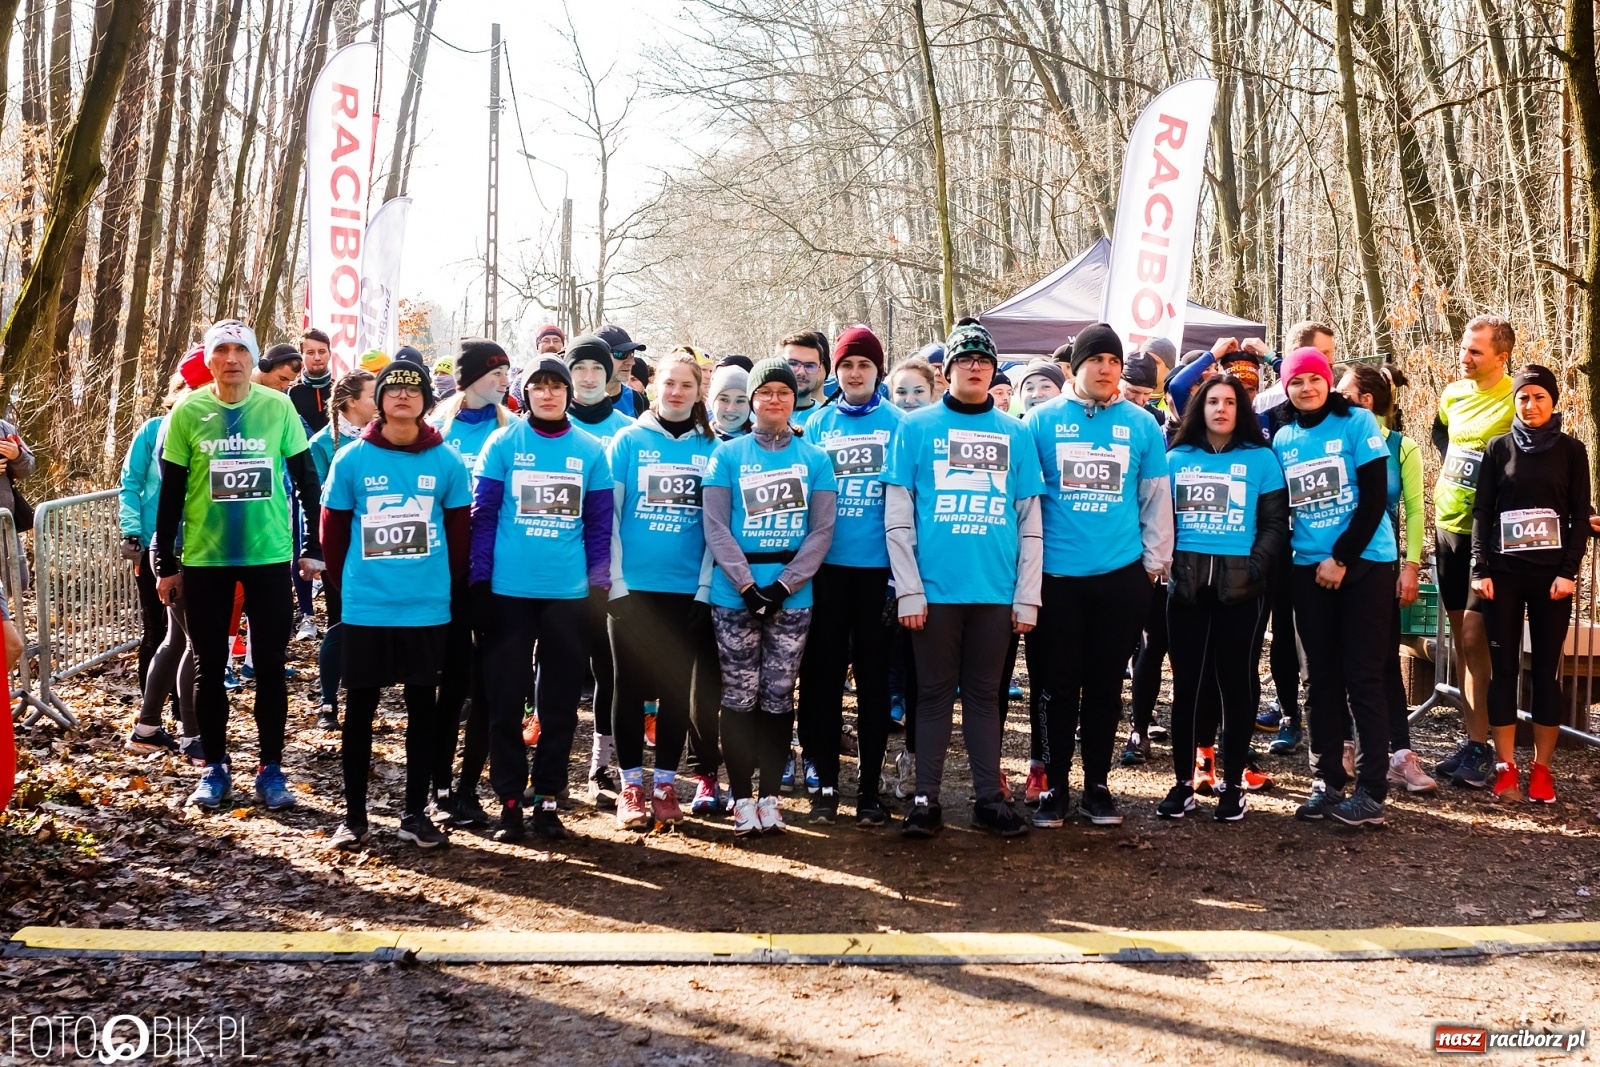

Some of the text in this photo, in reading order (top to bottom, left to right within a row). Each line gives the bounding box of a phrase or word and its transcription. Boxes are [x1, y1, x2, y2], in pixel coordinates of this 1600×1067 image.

[389, 369, 420, 378] STAR
[386, 376, 422, 385] WARS
[1055, 423, 1079, 433] DLO
[1114, 427, 1128, 437] TBI
[199, 432, 266, 456] synthos
[933, 439, 948, 448] DL
[638, 449, 661, 458] DLO
[836, 448, 872, 465] 023
[960, 444, 998, 461] 038
[740, 464, 762, 472] DLO
[1073, 463, 1110, 480] 005
[1232, 465, 1245, 475] TBI
[1448, 457, 1474, 476] 079
[223, 472, 261, 489] 027
[364, 475, 388, 486] DLO
[419, 476, 434, 488] TBI
[659, 477, 696, 495] 032
[1299, 472, 1329, 492] 134
[755, 482, 793, 503] 072
[837, 478, 883, 498] IEG
[1186, 486, 1215, 501] 126
[534, 486, 570, 504] 154
[836, 498, 884, 506] RDZIELA
[935, 494, 1007, 515] BIEG
[1072, 501, 1108, 512] 2022
[837, 508, 864, 517] 022
[514, 518, 576, 529] TWARDZIELA
[743, 513, 805, 529] BIEG
[933, 514, 1006, 526] TWARDZIELA
[1309, 516, 1340, 528] 2022
[526, 527, 559, 538] 2022
[648, 521, 682, 533] 2022
[742, 529, 805, 537] TWARDZIELA
[951, 524, 988, 535] 2022
[1182, 523, 1246, 532] TWARDZIELA
[1512, 521, 1548, 538] 044
[375, 526, 416, 545] 007
[759, 538, 790, 547] 2022
